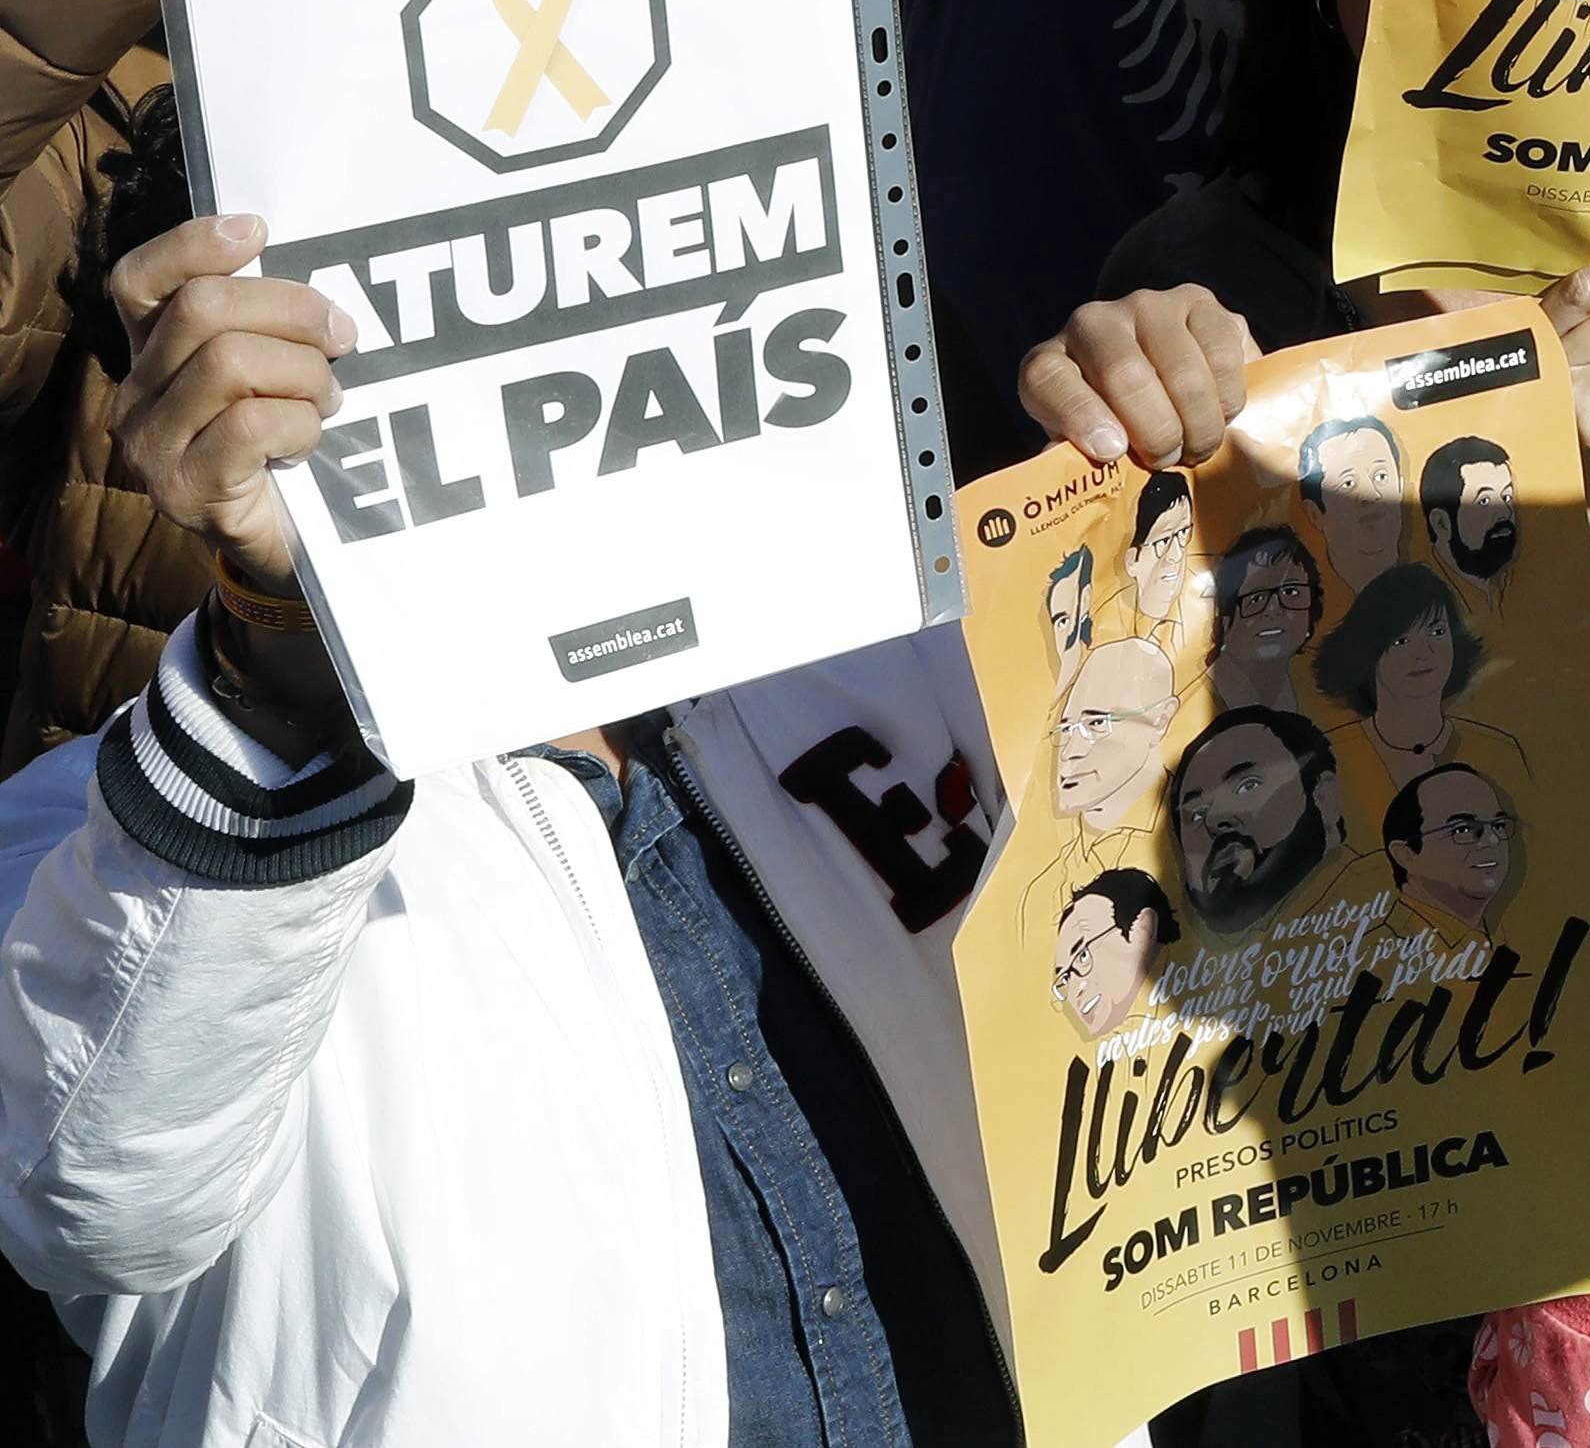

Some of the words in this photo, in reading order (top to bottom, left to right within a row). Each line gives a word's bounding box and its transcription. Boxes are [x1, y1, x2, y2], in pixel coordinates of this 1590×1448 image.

[302, 157, 828, 355] ATUREM
[312, 403, 487, 544] EL
[500, 300, 853, 499] PAÍS
[1405, 341, 1528, 395] assemblea.cat
[567, 616, 685, 665] assemblea.cat
[1039, 917, 1590, 1277] Llibertat!
[1102, 1220, 1202, 1292] SOM
[1211, 1129, 1509, 1252] REPÚBLICA
[1207, 1252, 1384, 1317] BARCELONA
